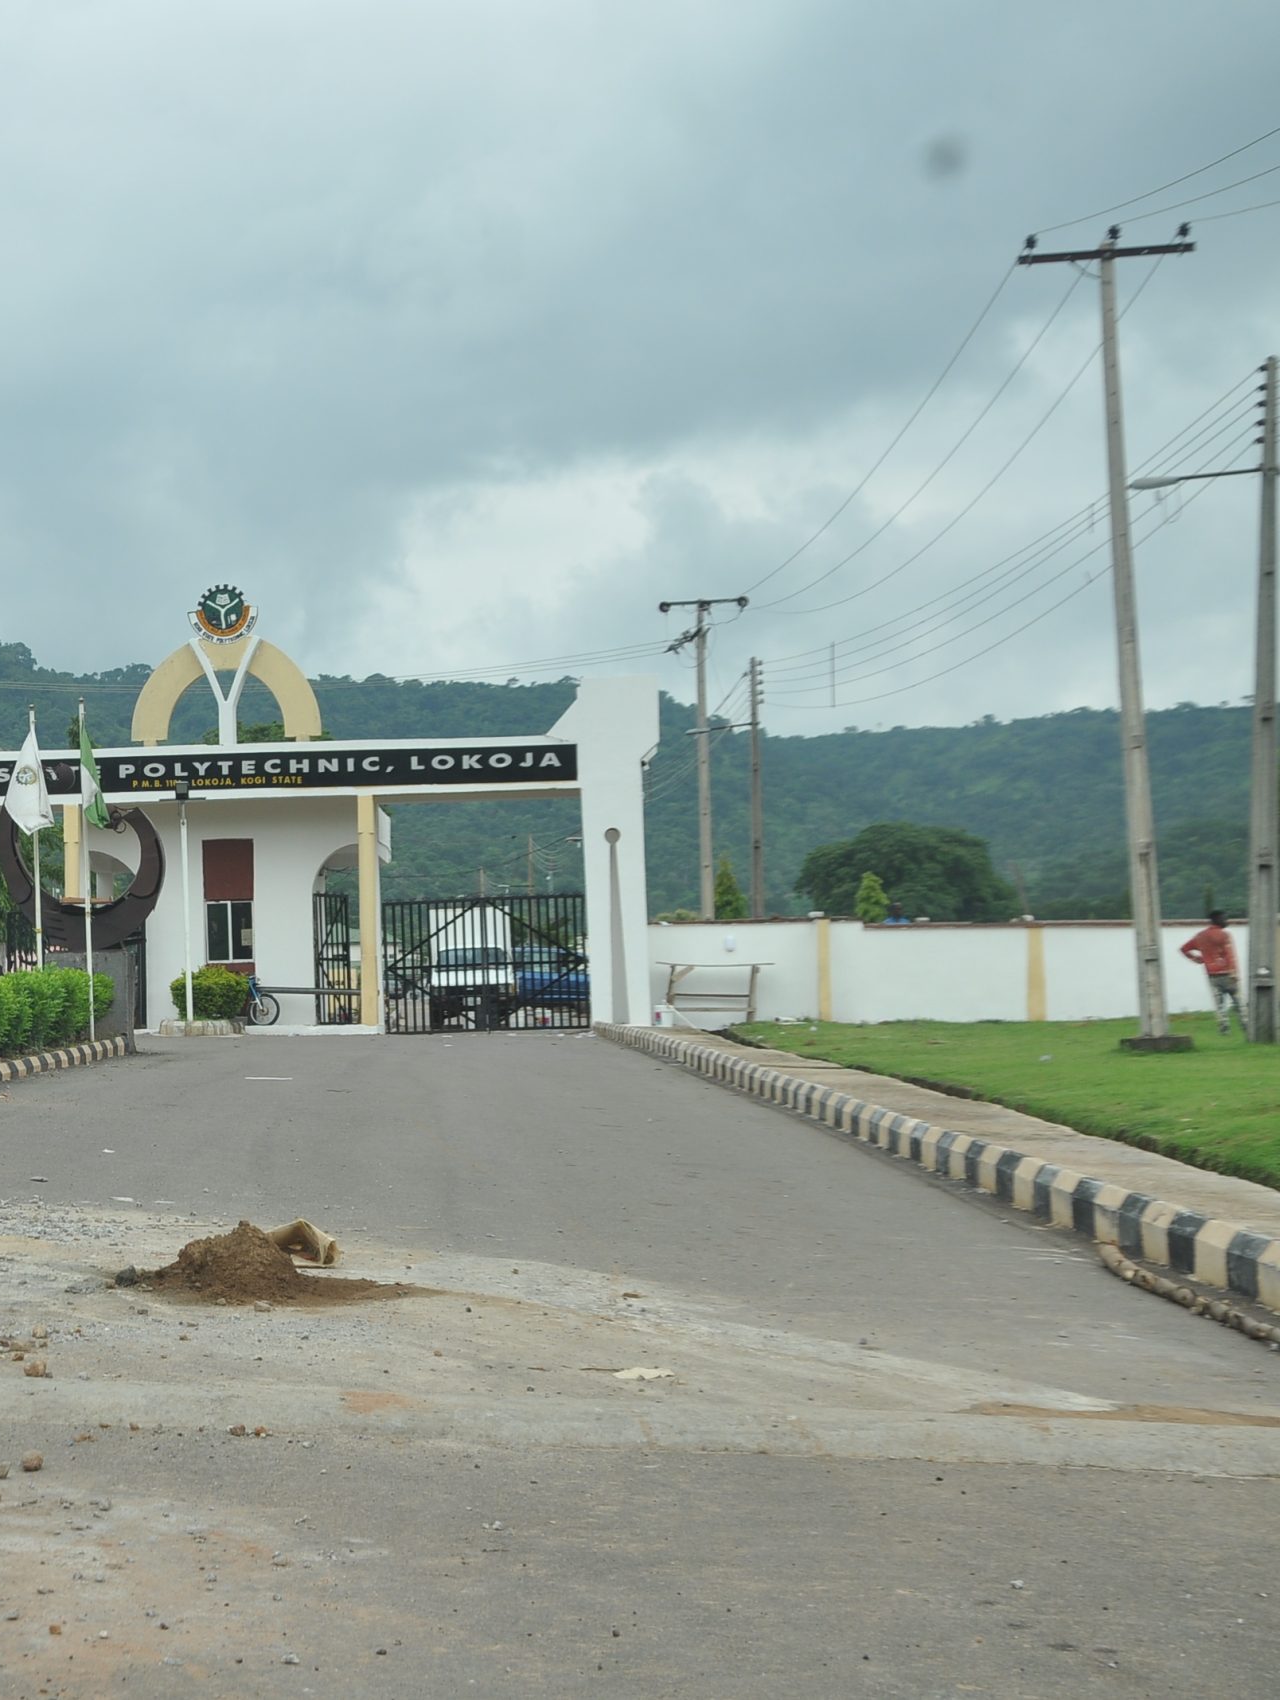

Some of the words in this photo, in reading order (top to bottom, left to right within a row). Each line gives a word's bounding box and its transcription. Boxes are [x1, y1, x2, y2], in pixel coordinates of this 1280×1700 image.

[118, 756, 395, 779] POLYTECHNIC,
[410, 752, 562, 770] LOKOJA
[191, 777, 236, 787] LOKOJA,
[240, 776, 266, 785] KOGI
[271, 775, 303, 784] STATE
